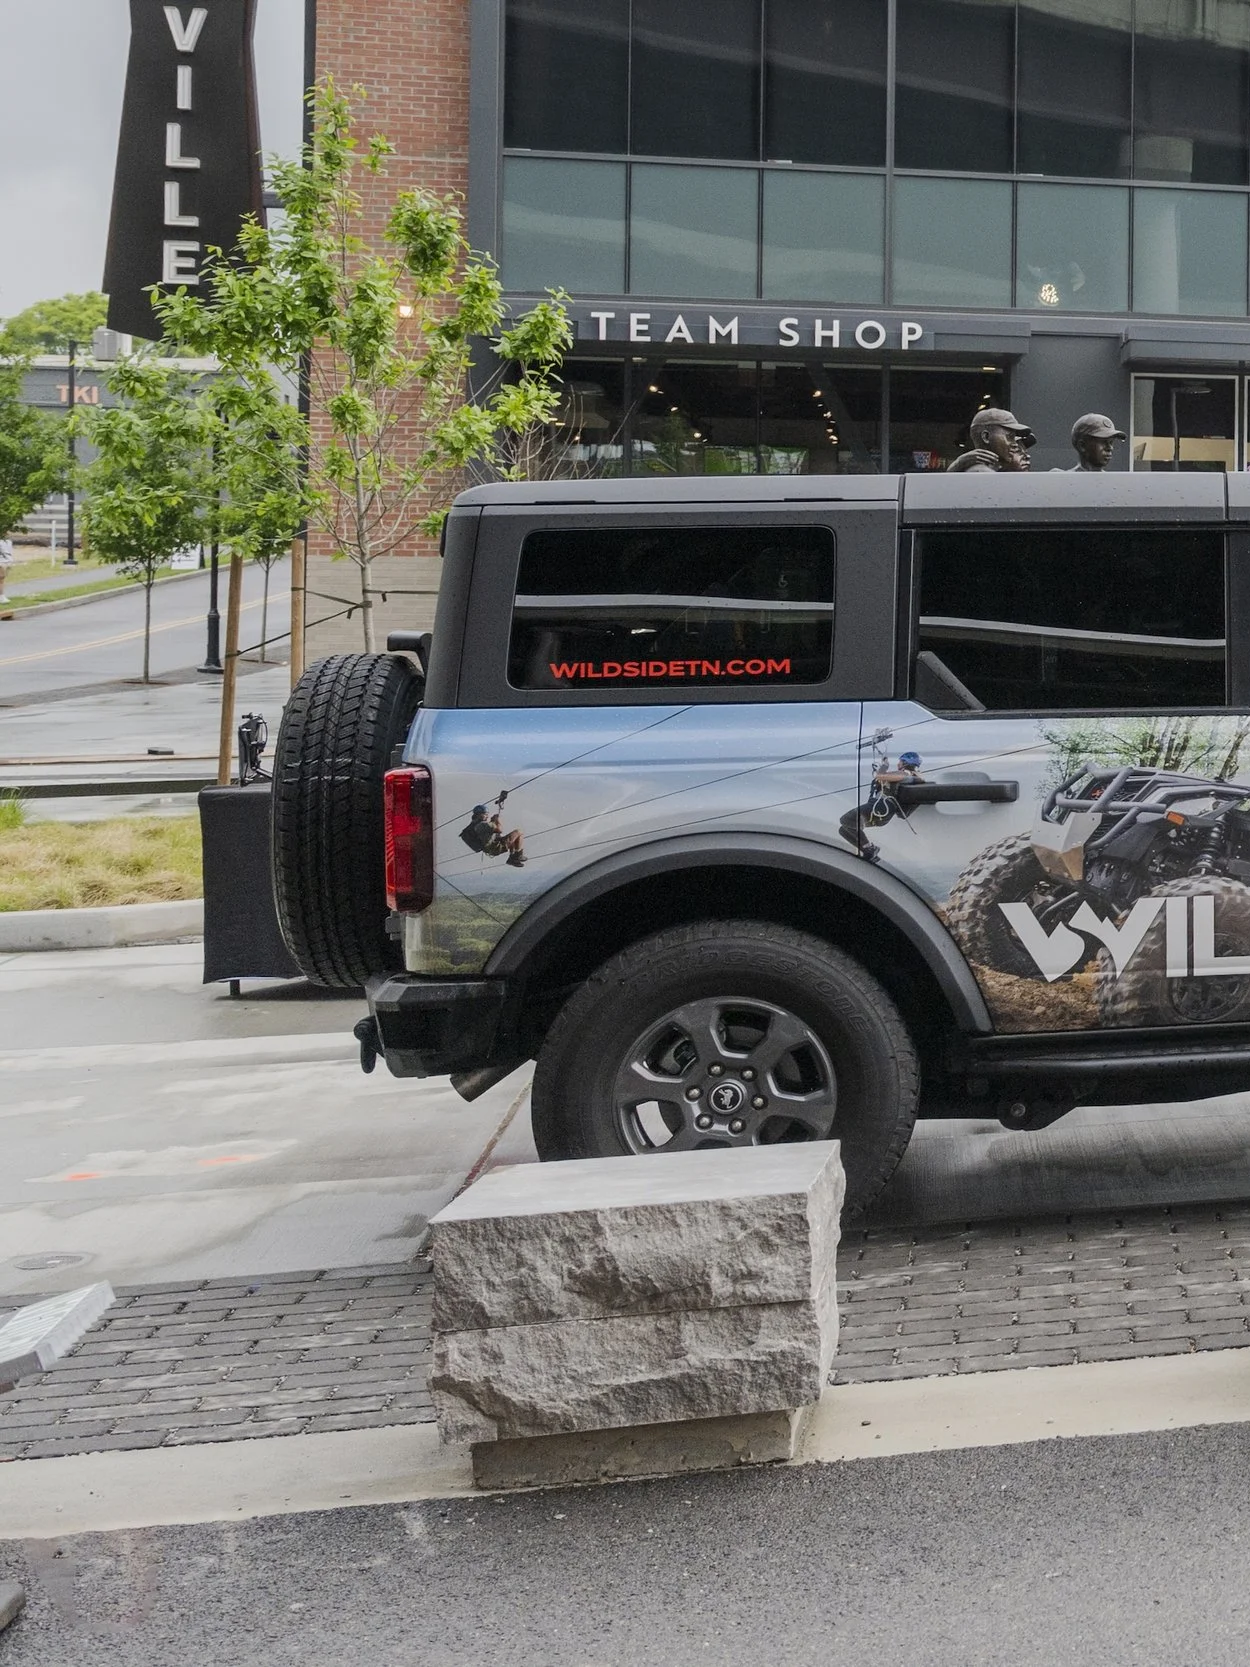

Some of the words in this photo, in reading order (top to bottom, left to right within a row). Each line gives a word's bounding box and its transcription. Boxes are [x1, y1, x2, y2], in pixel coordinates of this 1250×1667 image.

[162, 6, 208, 285] VILLE
[591, 311, 739, 345] TEAM
[778, 317, 923, 350] SHOP
[550, 658, 791, 679] WILDSIDETN.COM
